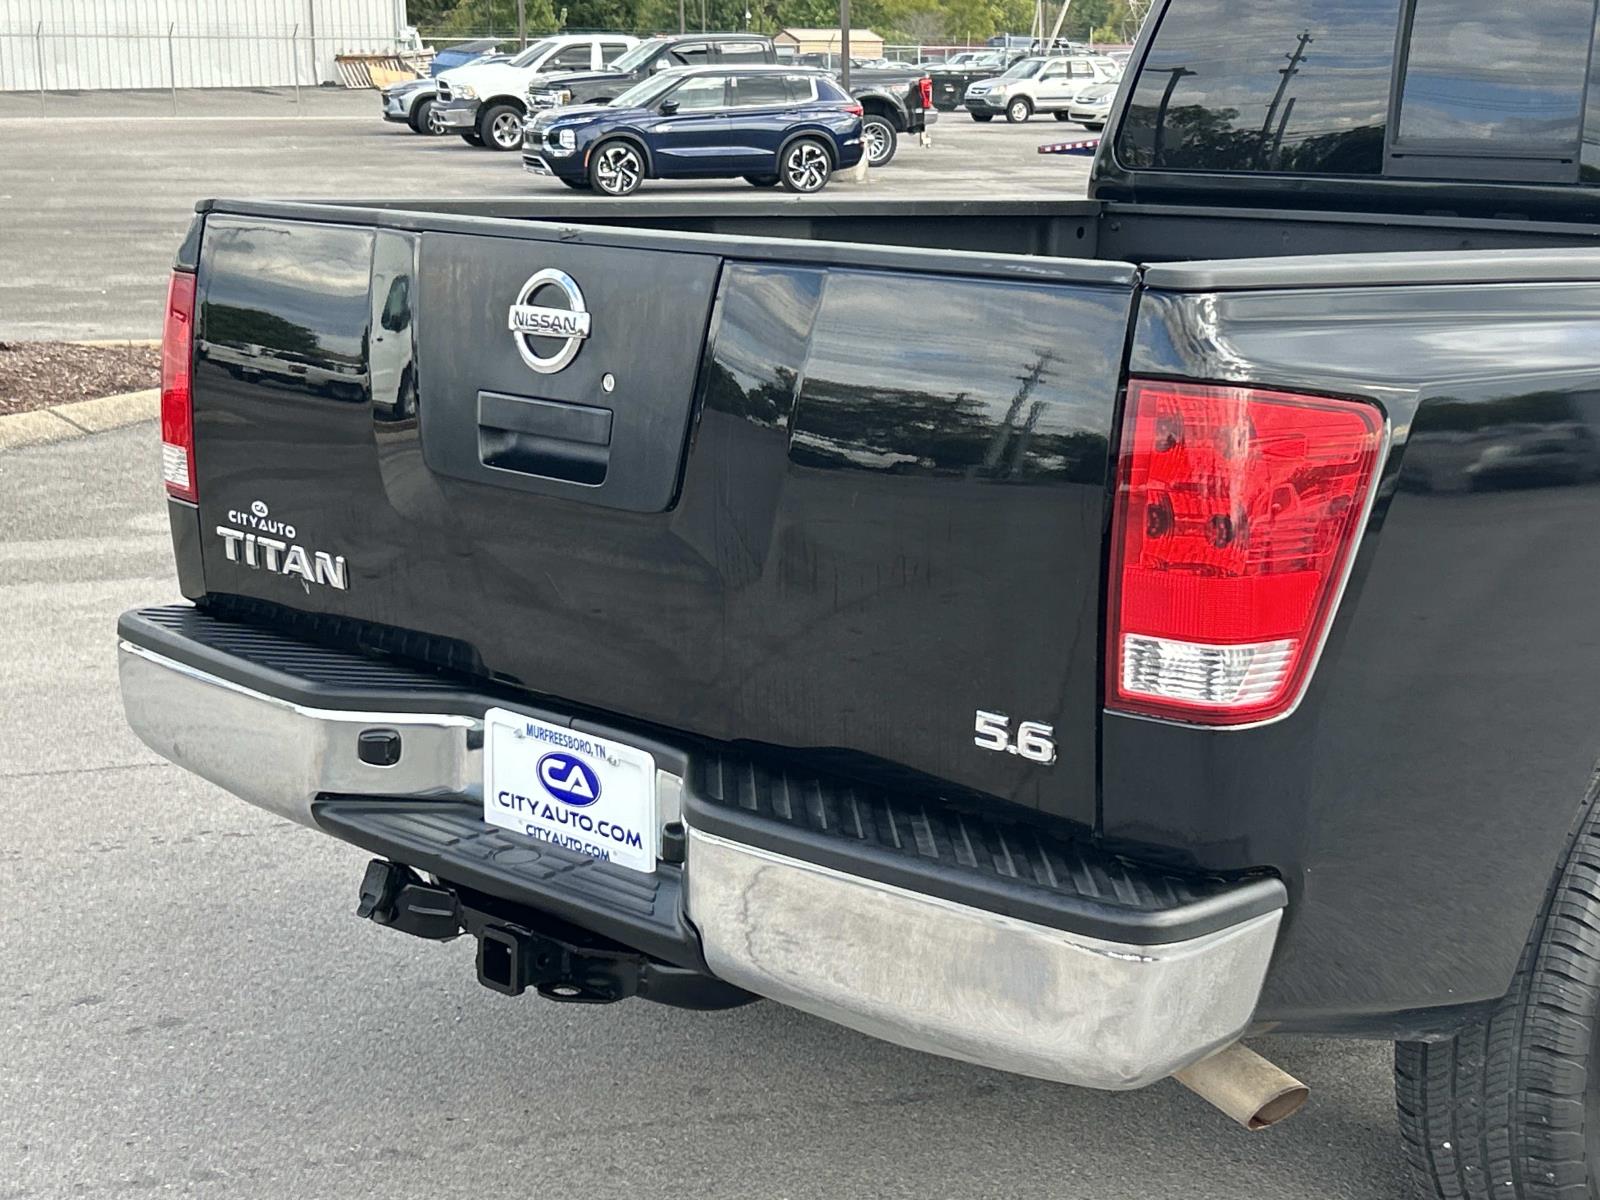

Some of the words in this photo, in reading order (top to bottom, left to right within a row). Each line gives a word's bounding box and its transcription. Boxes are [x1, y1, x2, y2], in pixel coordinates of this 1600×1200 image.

[514, 311, 577, 331] NISSAN
[228, 510, 296, 538] CITYAUTO
[216, 526, 346, 590] TITAN
[526, 723, 593, 755] MURFREESBORO,
[594, 743, 606, 759] TN
[974, 709, 1055, 763] 5.6
[498, 790, 643, 850] CITYAUTO.COM
[526, 823, 610, 862] CITYAUTO.COM
